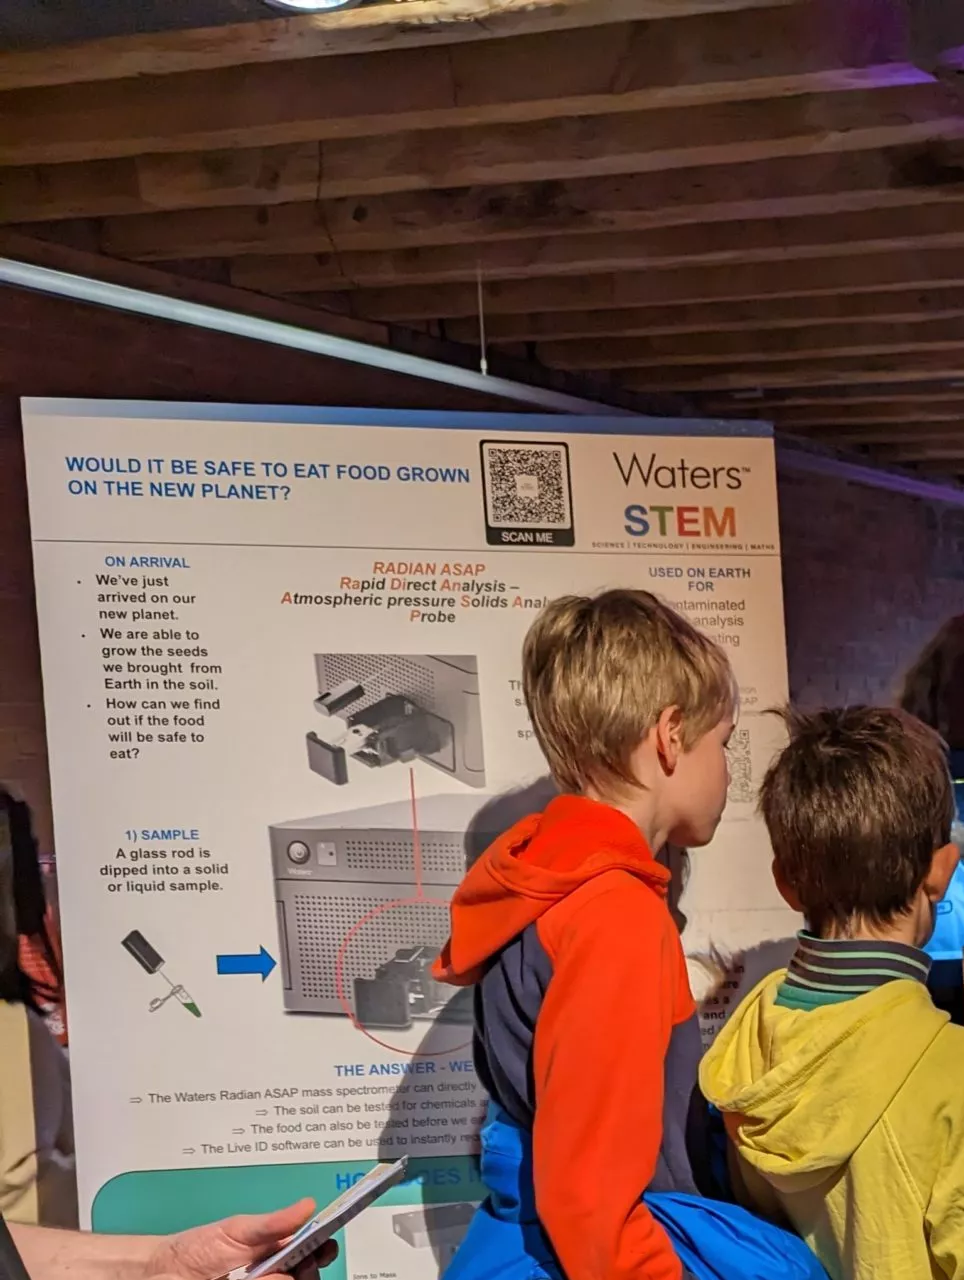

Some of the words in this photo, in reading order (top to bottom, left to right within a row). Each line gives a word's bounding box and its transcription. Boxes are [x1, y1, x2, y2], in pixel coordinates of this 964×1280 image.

[65, 456, 141, 474] WOULD
[147, 459, 164, 475] IT
[171, 459, 198, 475] BE
[203, 460, 256, 477] SAFE
[261, 462, 288, 478] TO
[294, 463, 329, 479] EAT
[336, 464, 391, 481] FOOD
[395, 466, 470, 483] GROWN
[68, 479, 97, 495] ON
[103, 481, 144, 496] THE
[150, 482, 195, 498] NEW
[202, 484, 290, 501] PLANET?
[624, 505, 736, 537] STEM
[501, 531, 533, 543] SCAN
[535, 532, 553, 543] ME
[105, 556, 126, 567] ON
[129, 557, 191, 569] ARRIVAL
[373, 561, 437, 576] RADIAN
[440, 563, 486, 576] ASAP
[648, 567, 683, 578] USED
[687, 567, 705, 578] ON
[708, 568, 751, 578] EARTH
[142, 575, 169, 589] just
[340, 577, 385, 593] Rapid
[390, 578, 437, 591] Direct
[439, 578, 506, 596] Analysis
[688, 581, 714, 592] FOR
[97, 592, 146, 603] arrived
[150, 594, 169, 604] on
[172, 594, 196, 604] our
[281, 591, 383, 609] Atmospheric
[387, 595, 456, 610] pressure
[460, 595, 508, 608] Solids
[99, 610, 127, 619] new
[132, 609, 179, 622] planet.
[410, 610, 456, 623] Probe
[100, 628, 122, 640] We
[126, 630, 149, 640] are
[152, 628, 182, 640] able
[185, 629, 200, 640] to
[101, 647, 137, 659] grow
[141, 645, 163, 657] the
[167, 646, 208, 657] seeds
[103, 663, 123, 673] we
[127, 662, 183, 676] brought
[190, 662, 223, 674] from
[104, 678, 142, 690] Earth
[146, 678, 159, 690] in
[163, 679, 185, 690] the
[189, 679, 218, 690] soil.
[106, 698, 137, 709] How
[141, 700, 166, 709] can
[170, 700, 190, 709] we
[194, 698, 221, 710] find
[107, 715, 131, 726] out
[134, 714, 144, 726] if
[147, 715, 169, 726] the
[173, 714, 205, 726] food
[108, 731, 132, 742] will
[136, 731, 153, 743] be
[157, 731, 187, 743] safe
[190, 732, 205, 743] to
[109, 748, 140, 759] eat?
[125, 830, 138, 842] 1)
[141, 829, 200, 841] SAMPLE
[115, 848, 126, 859] A
[129, 848, 167, 862] glass
[171, 848, 195, 859] rod
[199, 847, 211, 858] is
[99, 864, 148, 878] dipped
[152, 864, 179, 876] into
[183, 866, 191, 875] a
[195, 863, 229, 875] solid
[107, 883, 121, 892] or
[126, 880, 166, 894] liquid
[169, 879, 224, 893] sample.
[334, 1064, 365, 1077] THE
[368, 1062, 436, 1076] ANSWER
[448, 1060, 474, 1073] WE
[148, 1092, 172, 1104] The
[174, 1091, 216, 1103] Waters
[219, 1090, 262, 1101] Radian
[263, 1087, 299, 1099] ASAP
[302, 1087, 333, 1097] mass
[335, 1083, 410, 1098] spectrometer
[414, 1084, 435, 1093] can
[437, 1081, 477, 1093] directly
[273, 1105, 297, 1116] The
[299, 1104, 319, 1115] soil
[322, 1104, 344, 1114] can
[346, 1102, 361, 1113] be
[364, 1100, 400, 1112] tested
[402, 1100, 417, 1111] for
[420, 1098, 476, 1110] chemicals
[249, 1123, 274, 1135] The
[276, 1122, 302, 1134] food
[305, 1123, 327, 1132] can
[330, 1120, 353, 1131] also
[356, 1119, 371, 1130] be
[374, 1117, 409, 1129] tested
[411, 1116, 448, 1128] before
[450, 1117, 467, 1125] we
[200, 1143, 224, 1155] The
[227, 1142, 251, 1153] Live
[255, 1141, 268, 1152] ID
[271, 1140, 320, 1151] software
[323, 1138, 345, 1148] can
[348, 1136, 363, 1147] be
[365, 1135, 393, 1146] used
[396, 1135, 408, 1145] to
[411, 1132, 457, 1145] instantly
